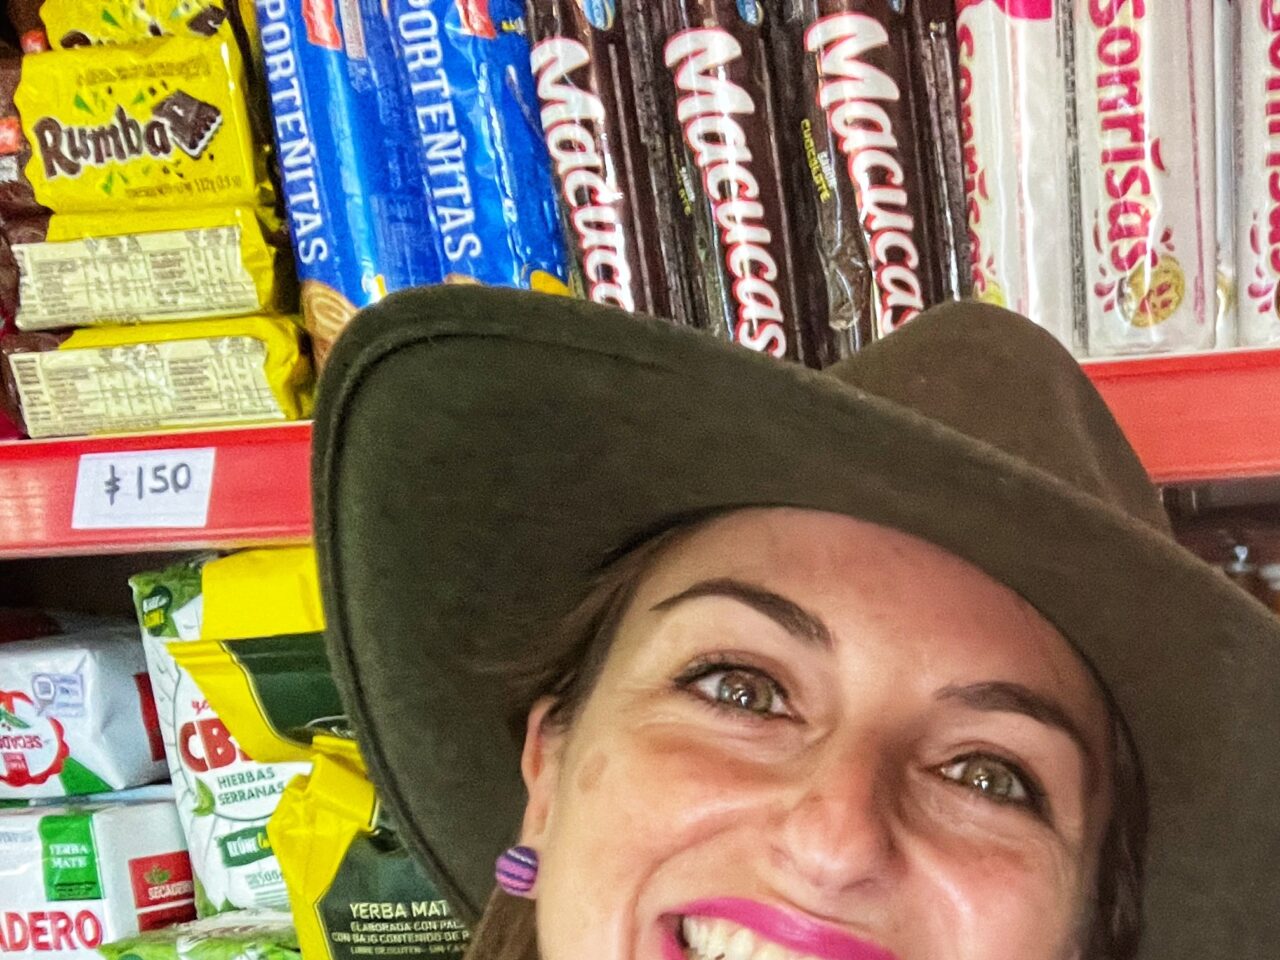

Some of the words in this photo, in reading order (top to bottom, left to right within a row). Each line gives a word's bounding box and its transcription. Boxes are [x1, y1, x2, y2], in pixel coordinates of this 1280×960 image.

[33, 104, 173, 179] Rumba
[664, 27, 787, 359] Macucas
[104, 462, 192, 507] $150
[180, 717, 253, 773] CB
[217, 766, 276, 790] HIERBAS
[217, 783, 286, 807] SERRANAS
[349, 902, 407, 919] YERBA
[411, 900, 450, 918] MAT
[350, 921, 412, 932] ELABORADA
[414, 920, 437, 931] CON
[379, 931, 442, 944] CONTENIDO
[443, 932, 460, 942] DE
